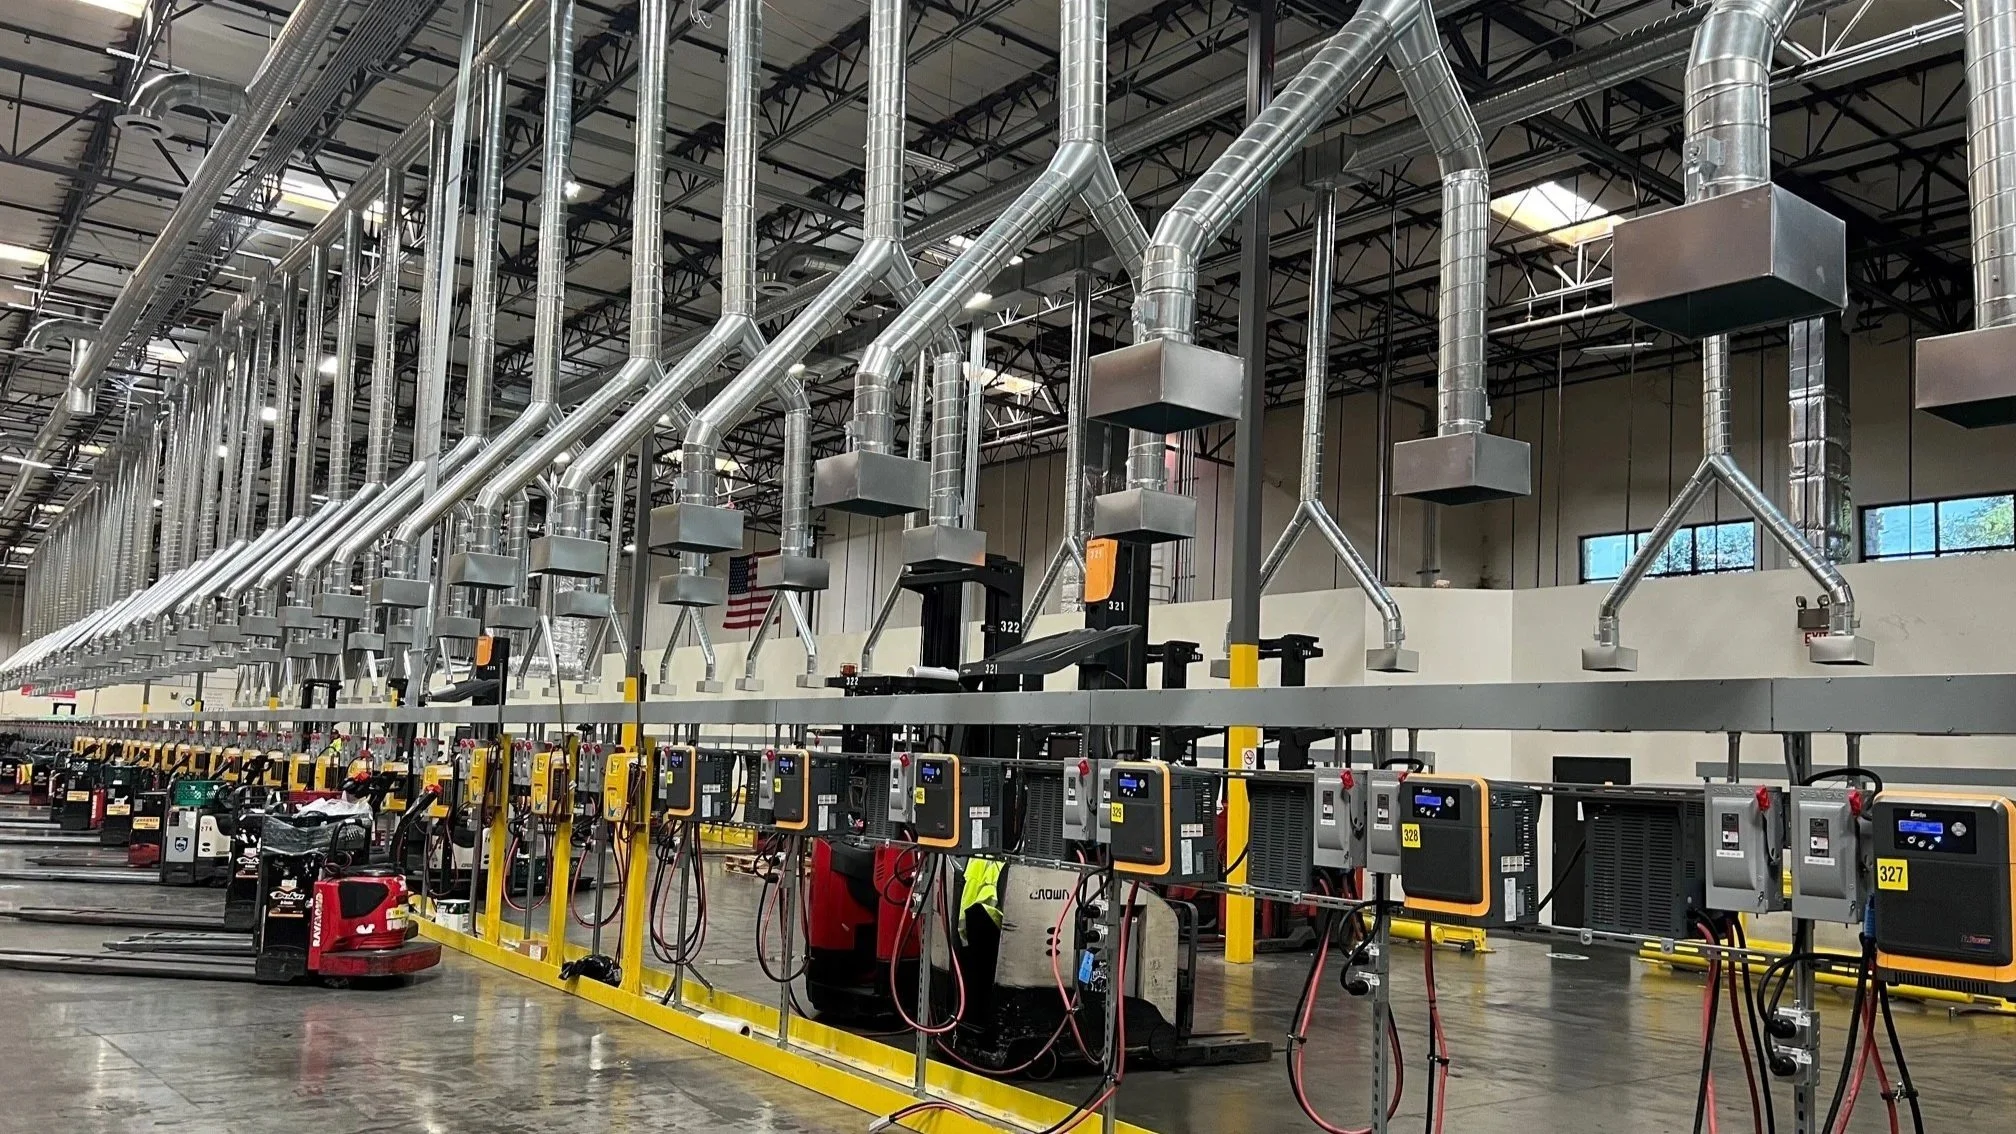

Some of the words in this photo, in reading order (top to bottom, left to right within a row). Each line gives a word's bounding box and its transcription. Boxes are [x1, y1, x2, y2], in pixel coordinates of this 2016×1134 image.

[1109, 601, 1124, 611] 321
[1000, 621, 1020, 633] 322
[985, 664, 998, 674] 321
[846, 677, 858, 685] 322
[1112, 807, 1122, 817] 329
[1404, 829, 1418, 841] 328
[1880, 866, 1903, 882] 327
[313, 893, 323, 947] RAYMOND
